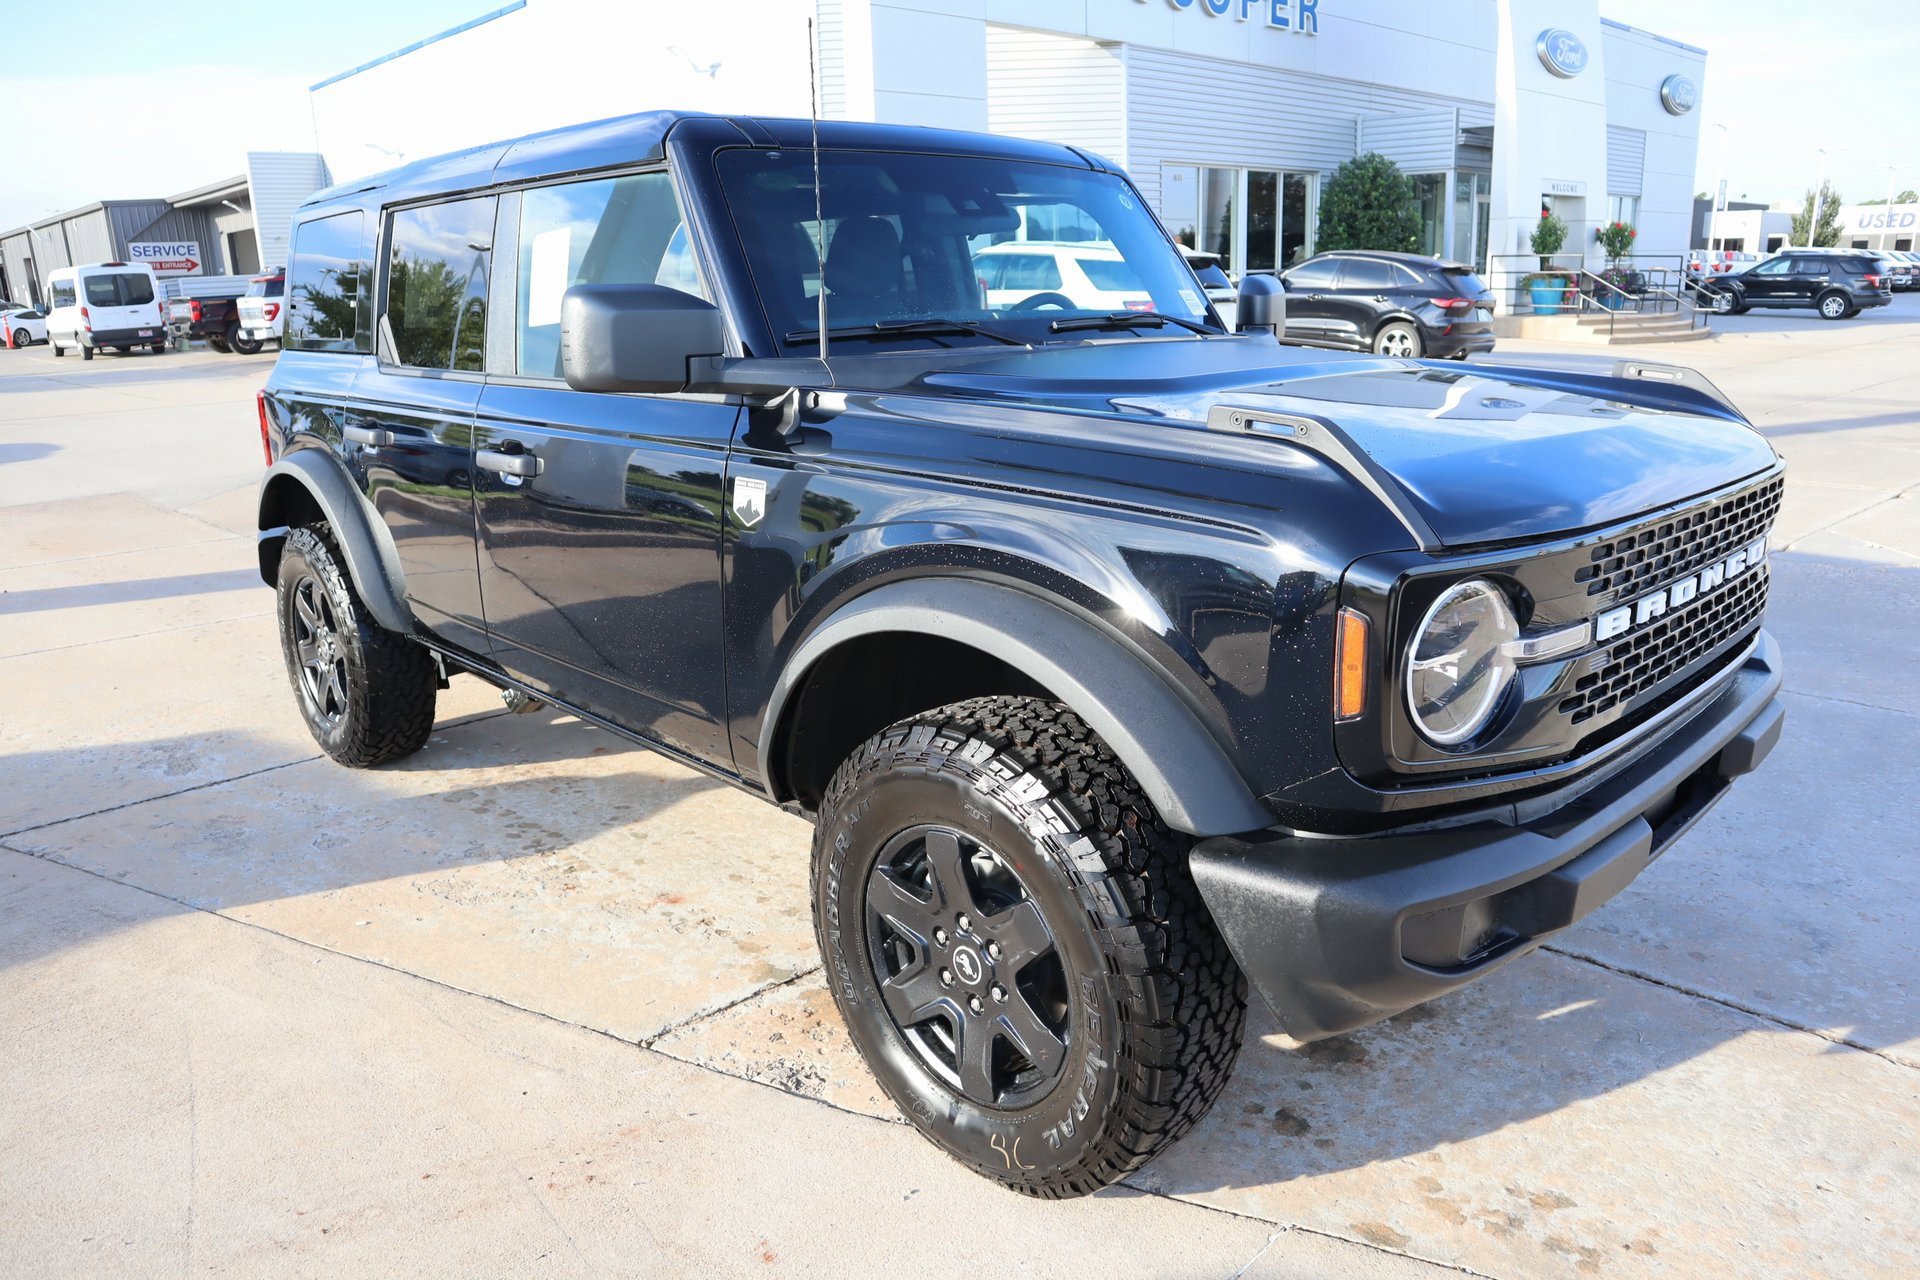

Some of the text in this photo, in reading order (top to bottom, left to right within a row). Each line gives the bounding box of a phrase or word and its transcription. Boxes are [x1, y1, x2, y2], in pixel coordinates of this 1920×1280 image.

[1135, 0, 1319, 35] PER
[1557, 37, 1582, 66] Ford
[1675, 83, 1694, 105] Ford
[1551, 182, 1579, 193] WELCOME
[1858, 212, 1917, 229] USED
[132, 244, 196, 257] SERVICE
[162, 261, 192, 270] ENTRANCE
[1595, 538, 1766, 642] BRONCO
[826, 831, 860, 1006] GRABBER
[1041, 973, 1103, 1149] GENERAL
